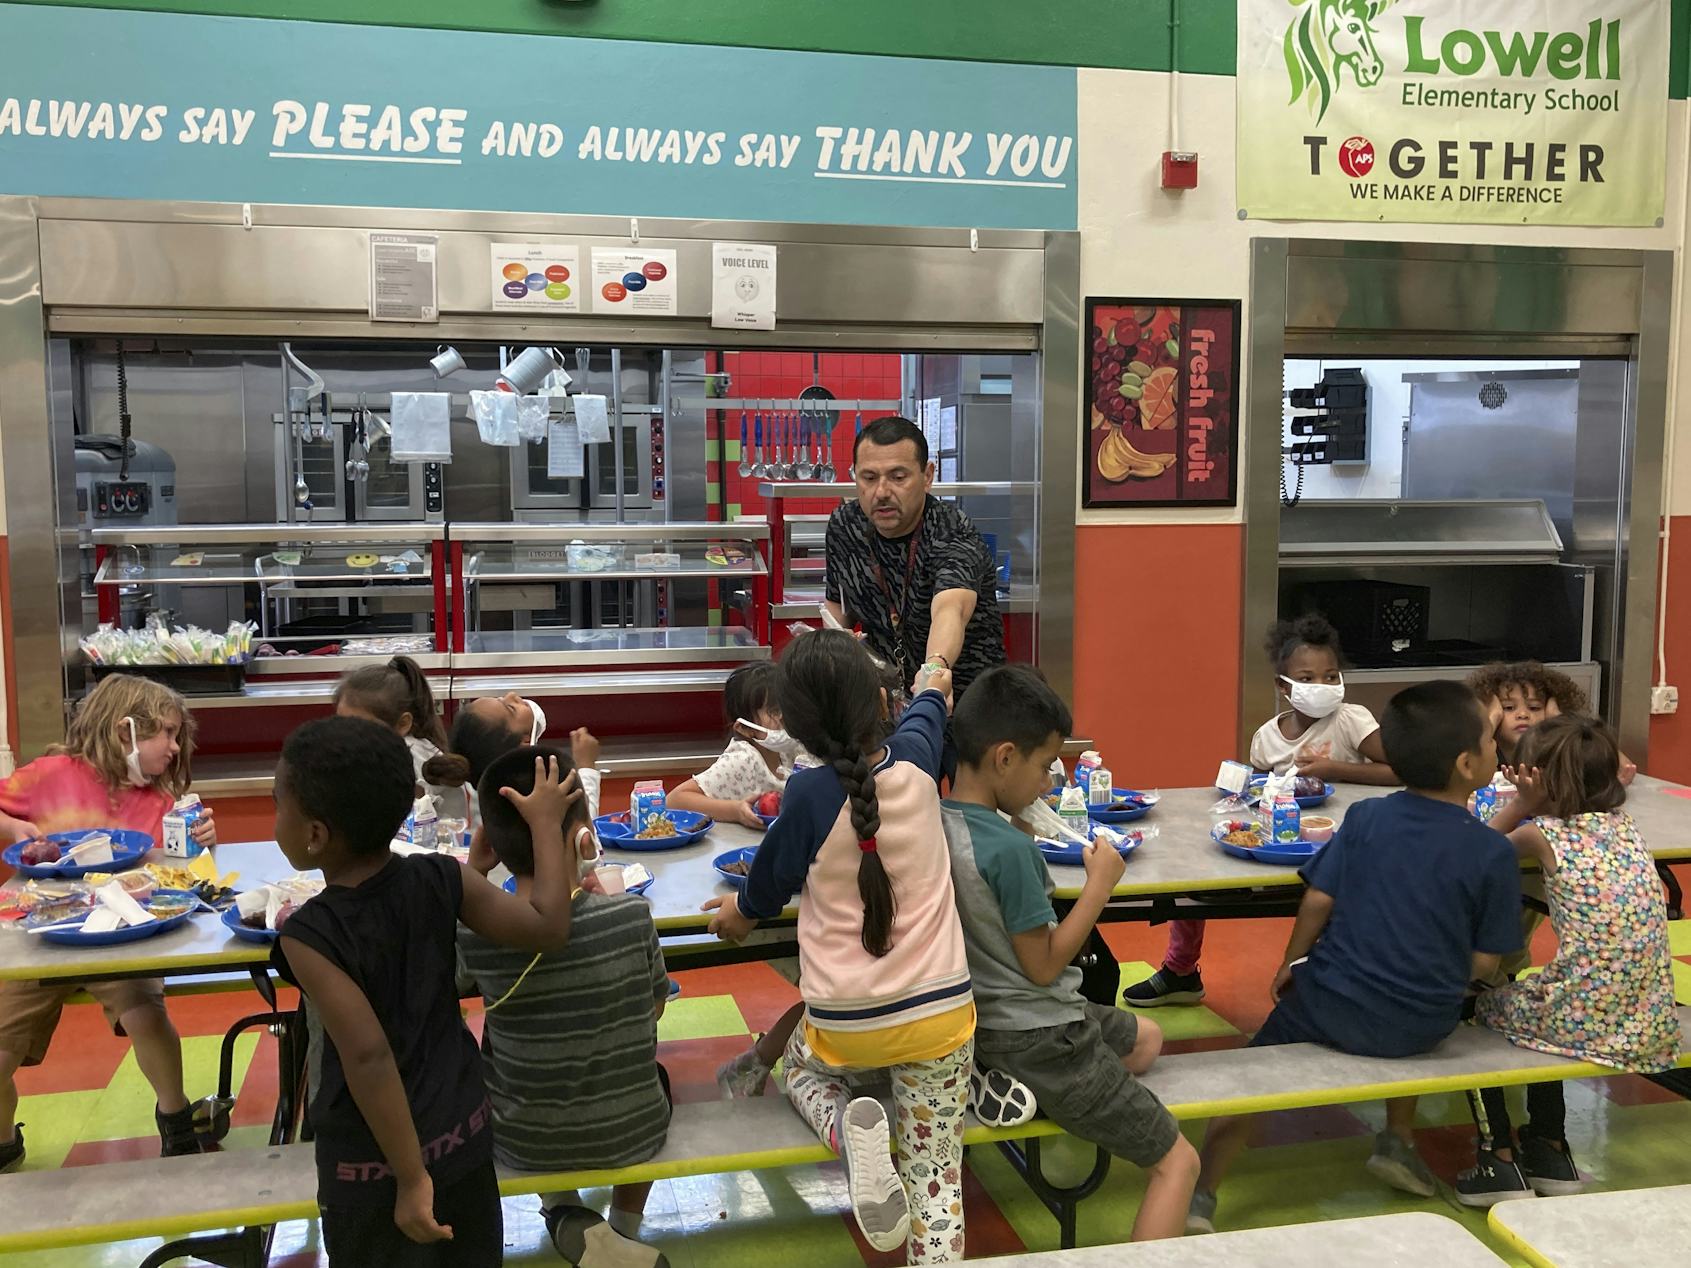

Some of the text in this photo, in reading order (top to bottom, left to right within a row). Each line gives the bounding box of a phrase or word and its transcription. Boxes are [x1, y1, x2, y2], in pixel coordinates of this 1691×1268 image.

[1403, 16, 1621, 81] Lowell
[1401, 83, 1619, 115] Elementary School
[0, 98, 1073, 179] ALWAYS SAY PLEASE AND ALWAYS SAY THANK YOU
[1354, 152, 1374, 165] APS
[1350, 183, 1563, 204] WE MAKE A DIFFERENCE
[371, 235, 408, 243] CAFETERIA
[722, 257, 769, 269] VOICE LEVEL
[1187, 329, 1214, 482] fresh fruit
